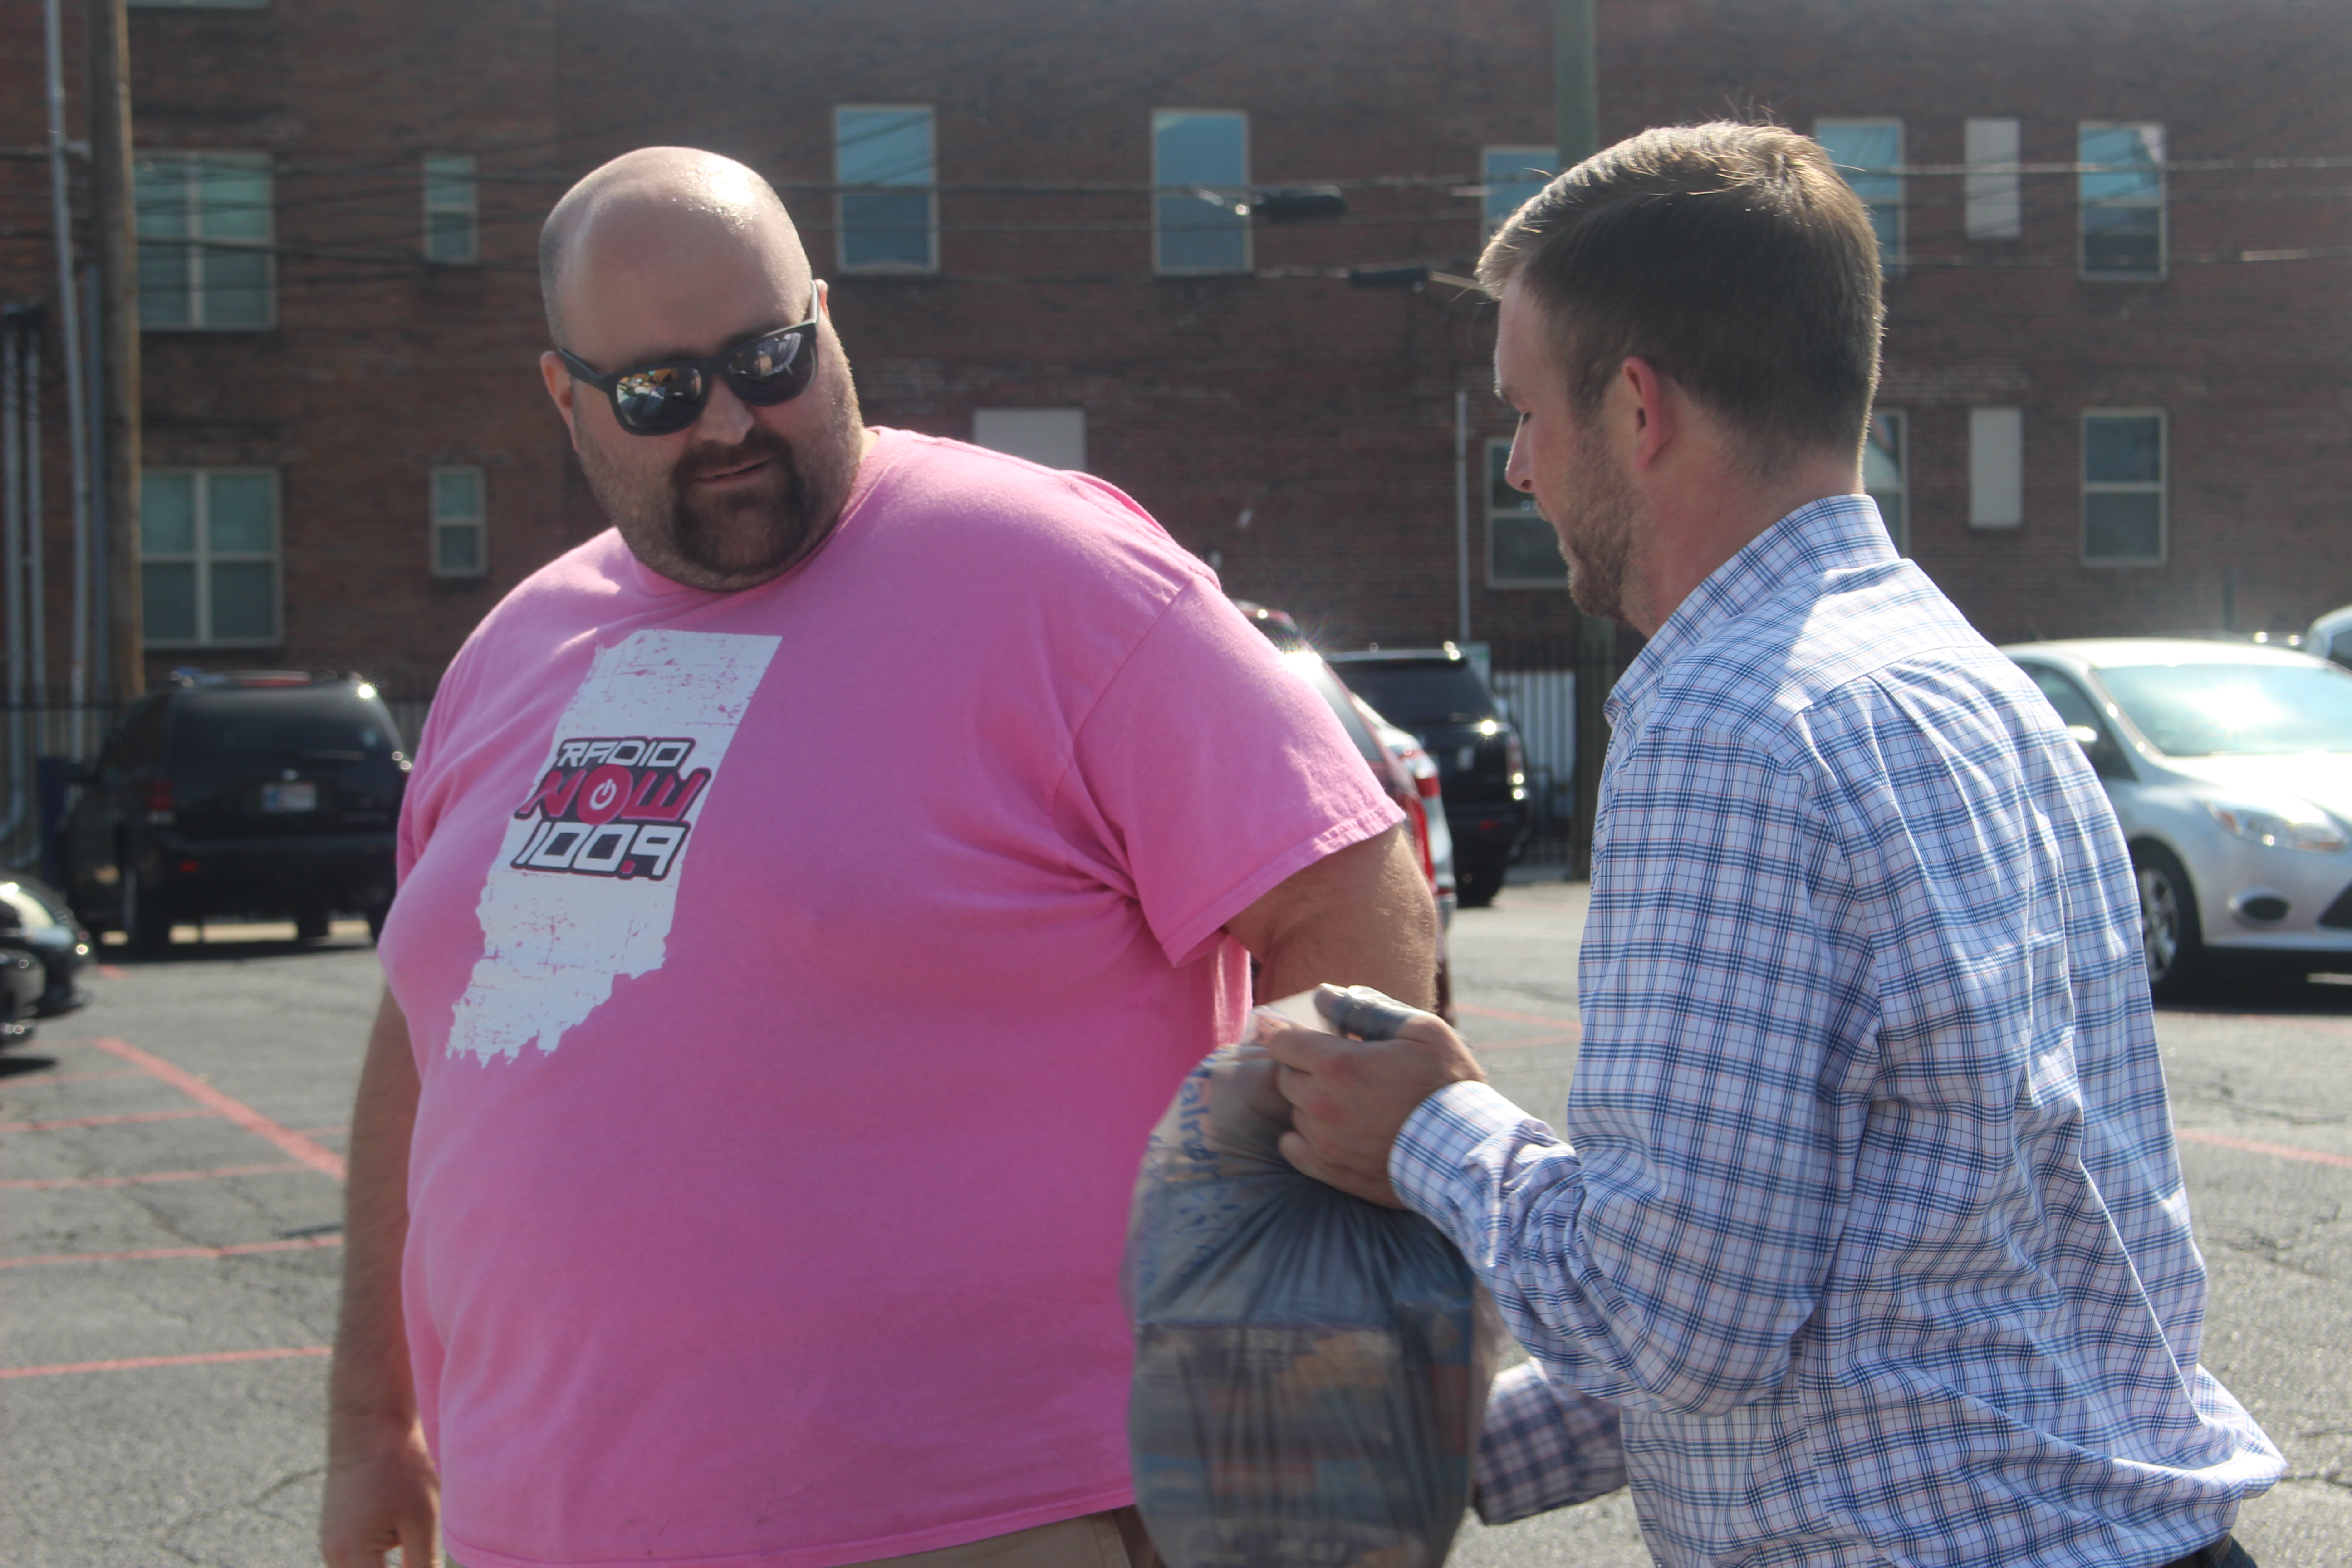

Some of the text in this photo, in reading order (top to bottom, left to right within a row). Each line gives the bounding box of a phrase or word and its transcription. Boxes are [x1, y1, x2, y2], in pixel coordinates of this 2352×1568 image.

[557, 740, 693, 768] RADIO
[516, 764, 708, 826] NOW
[514, 822, 687, 877] 100.9
